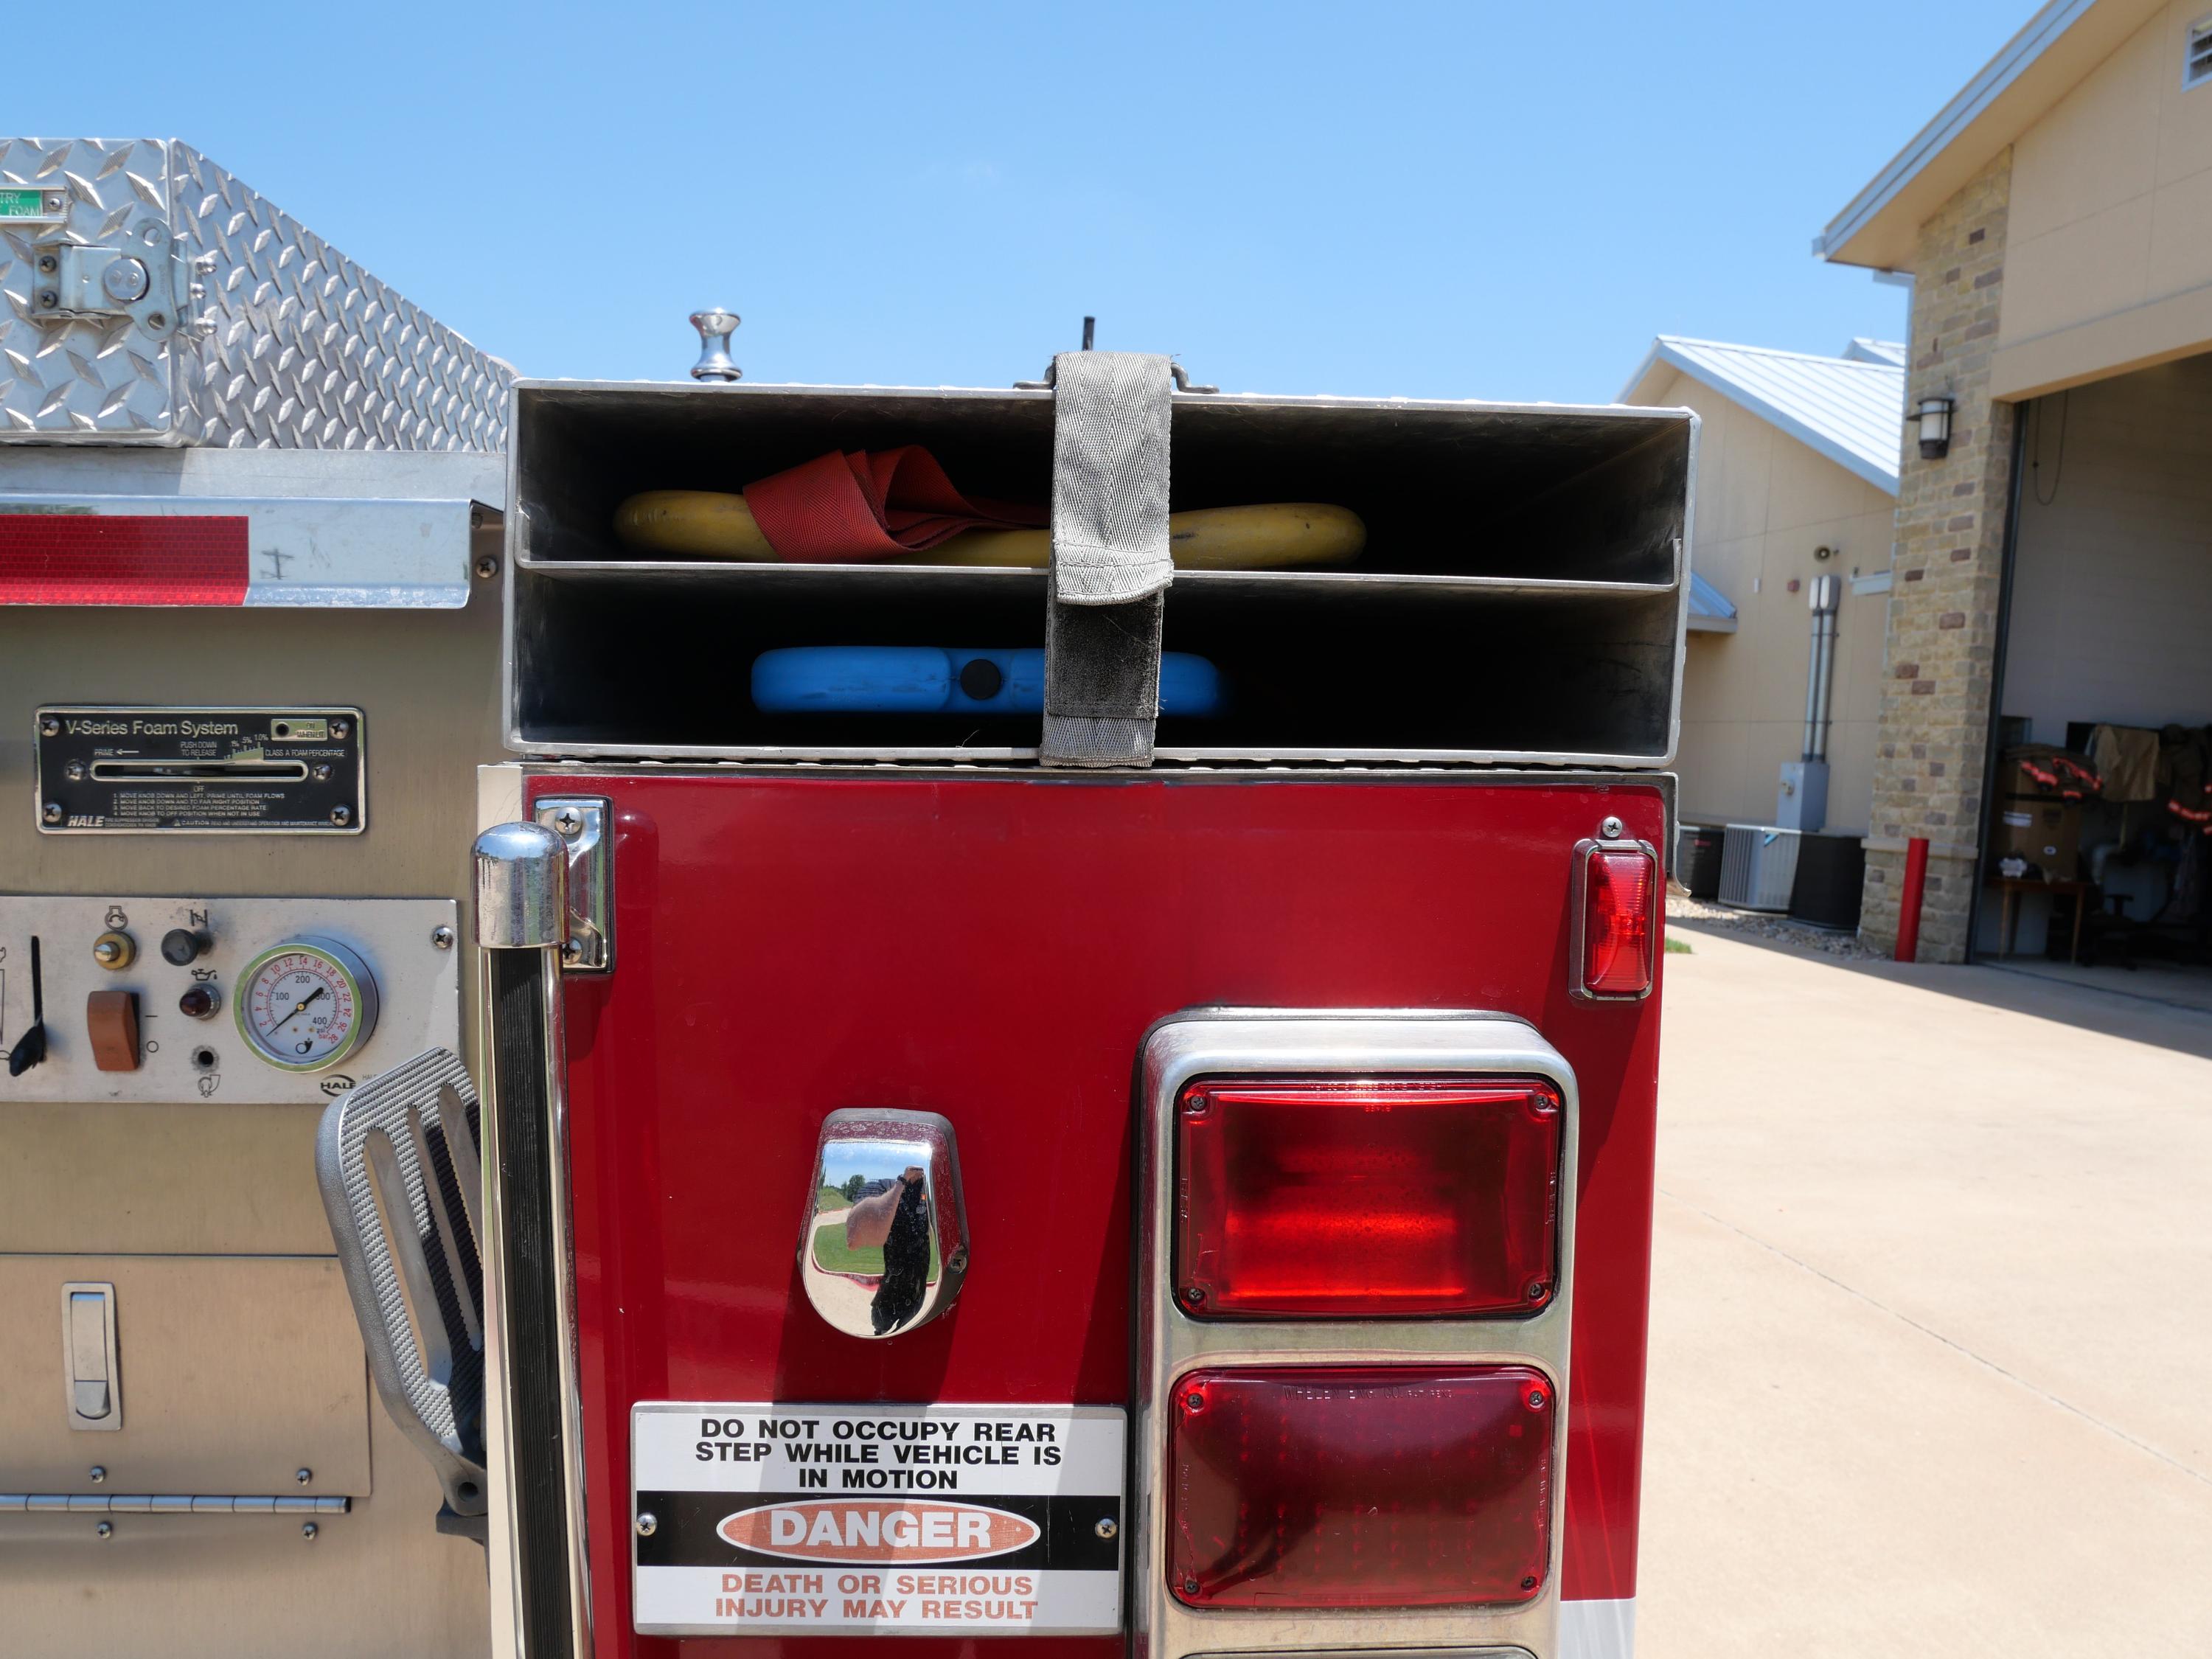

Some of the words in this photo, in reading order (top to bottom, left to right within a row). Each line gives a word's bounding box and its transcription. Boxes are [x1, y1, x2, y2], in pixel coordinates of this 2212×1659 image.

[10, 206, 39, 216] FOAM
[66, 720, 128, 735] V-Series
[133, 720, 178, 735] Foam
[181, 720, 238, 737] System
[67, 815, 105, 827] HALE
[283, 958, 293, 967] 12
[299, 956, 307, 964] 14
[313, 959, 323, 968] 16
[271, 964, 281, 974] 10
[327, 967, 336, 976] 18
[337, 978, 347, 989] 20
[276, 992, 290, 1001] 100
[342, 993, 352, 1002] 22
[344, 1008, 352, 1018] 24
[338, 1022, 347, 1032] 26
[328, 1034, 338, 1044] 28
[1283, 1385, 1340, 1400] WHELEN
[701, 1419, 744, 1439] DO
[759, 1420, 819, 1439] NOT
[832, 1421, 960, 1441] OCCUPY
[974, 1423, 1056, 1442] REAR
[695, 1442, 772, 1462] STEP
[785, 1443, 880, 1464] WHILE
[894, 1444, 1019, 1465] VEHICLE
[1034, 1446, 1061, 1466] IS
[799, 1469, 827, 1488] IN
[842, 1470, 958, 1489] MOTION
[771, 1510, 991, 1548] DANGER
[721, 1573, 823, 1593] DEATH
[837, 1575, 881, 1594] OR
[896, 1575, 1033, 1596] SERIOUS
[715, 1598, 828, 1618] INJURY
[843, 1599, 907, 1618] MAY
[921, 1600, 1038, 1620] RESULT
